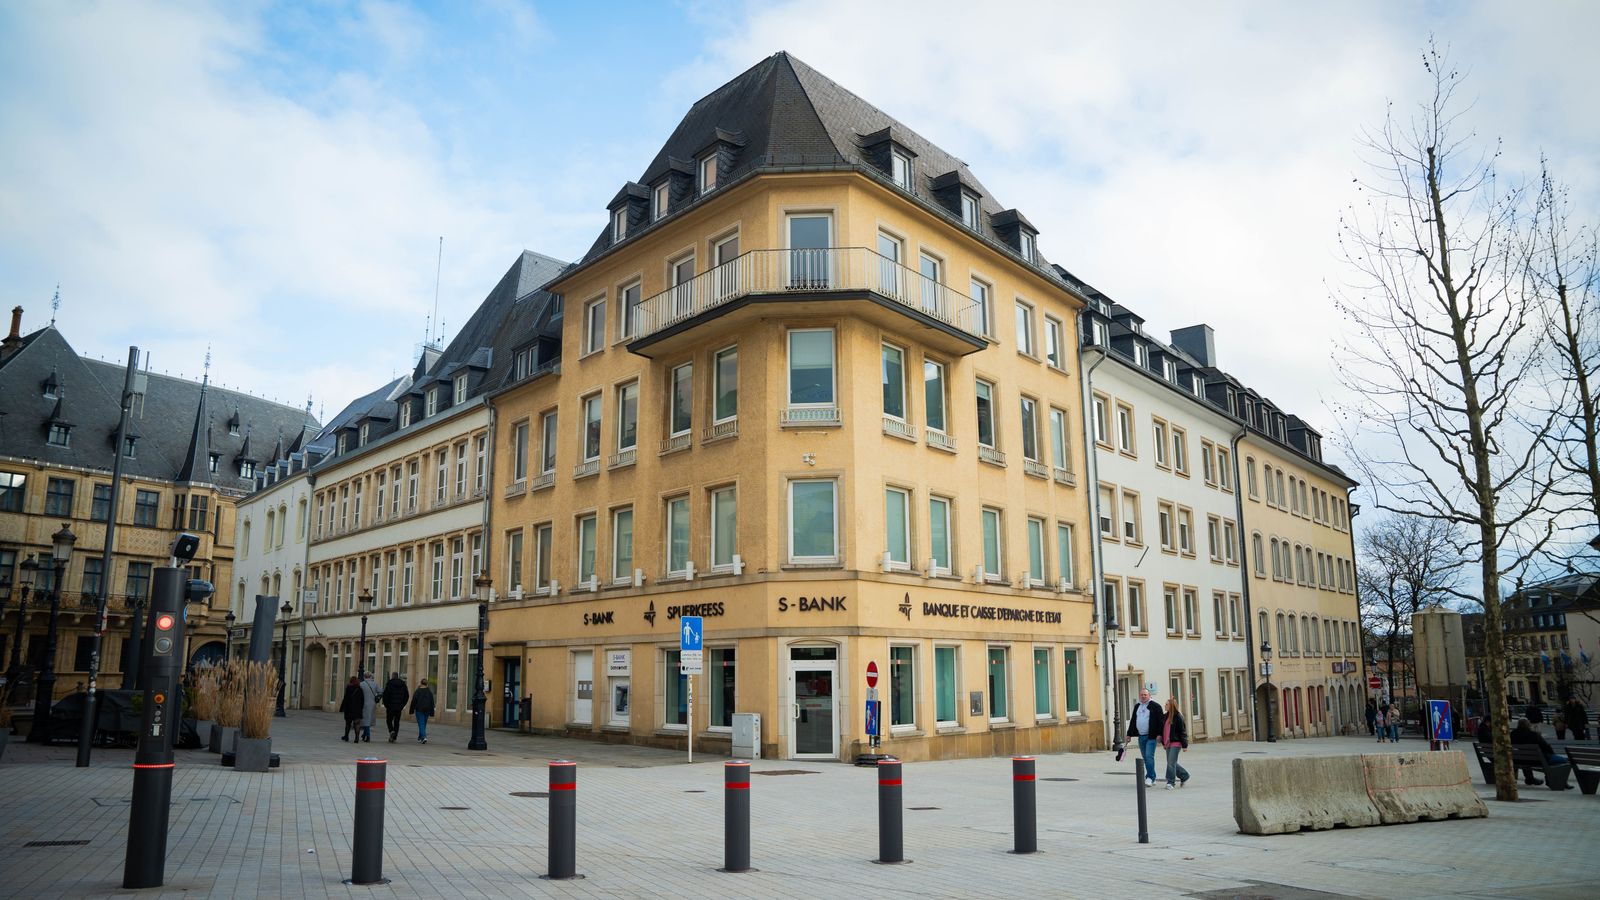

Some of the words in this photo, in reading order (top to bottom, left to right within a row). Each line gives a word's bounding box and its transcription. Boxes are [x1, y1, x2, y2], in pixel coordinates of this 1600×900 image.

[583, 611, 615, 626] S-BANK
[667, 601, 725, 620] SPUERKEESS
[923, 602, 959, 618] BANQUE
[960, 604, 970, 618] ET
[970, 605, 996, 620] CAISSE
[1035, 610, 1044, 622] DE
